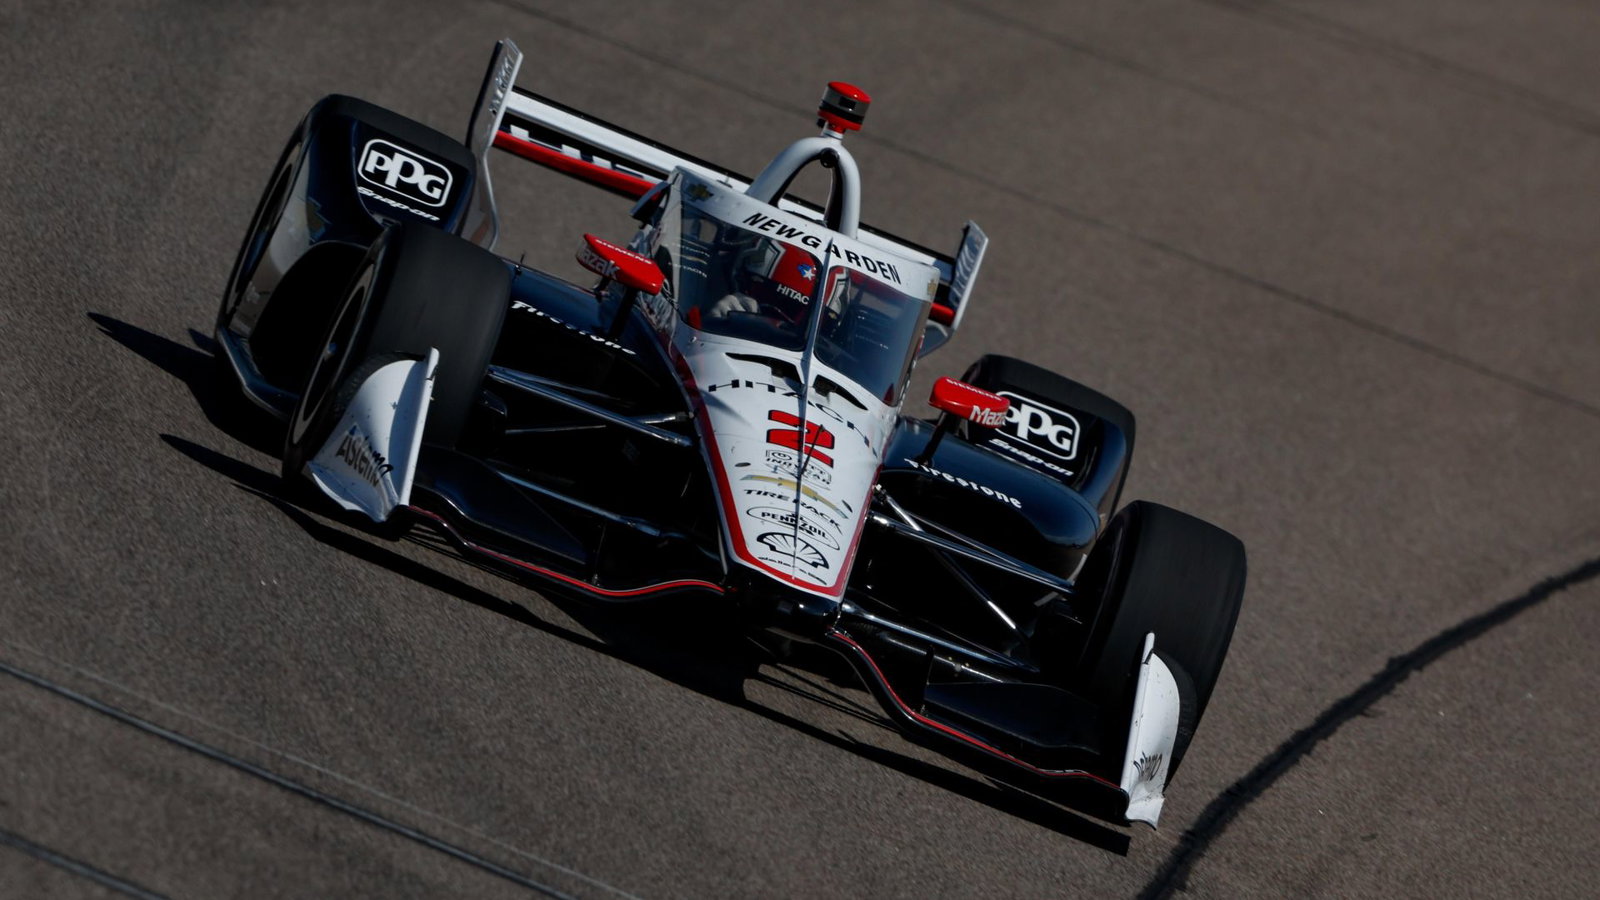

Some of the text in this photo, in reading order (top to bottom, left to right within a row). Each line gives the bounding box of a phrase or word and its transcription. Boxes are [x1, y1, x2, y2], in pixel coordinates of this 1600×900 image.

[364, 149, 445, 200] PPG
[743, 213, 902, 285] NEWGARDEN
[776, 283, 811, 306] HITAC
[766, 409, 835, 469] 2
[743, 489, 790, 501] TIRE
